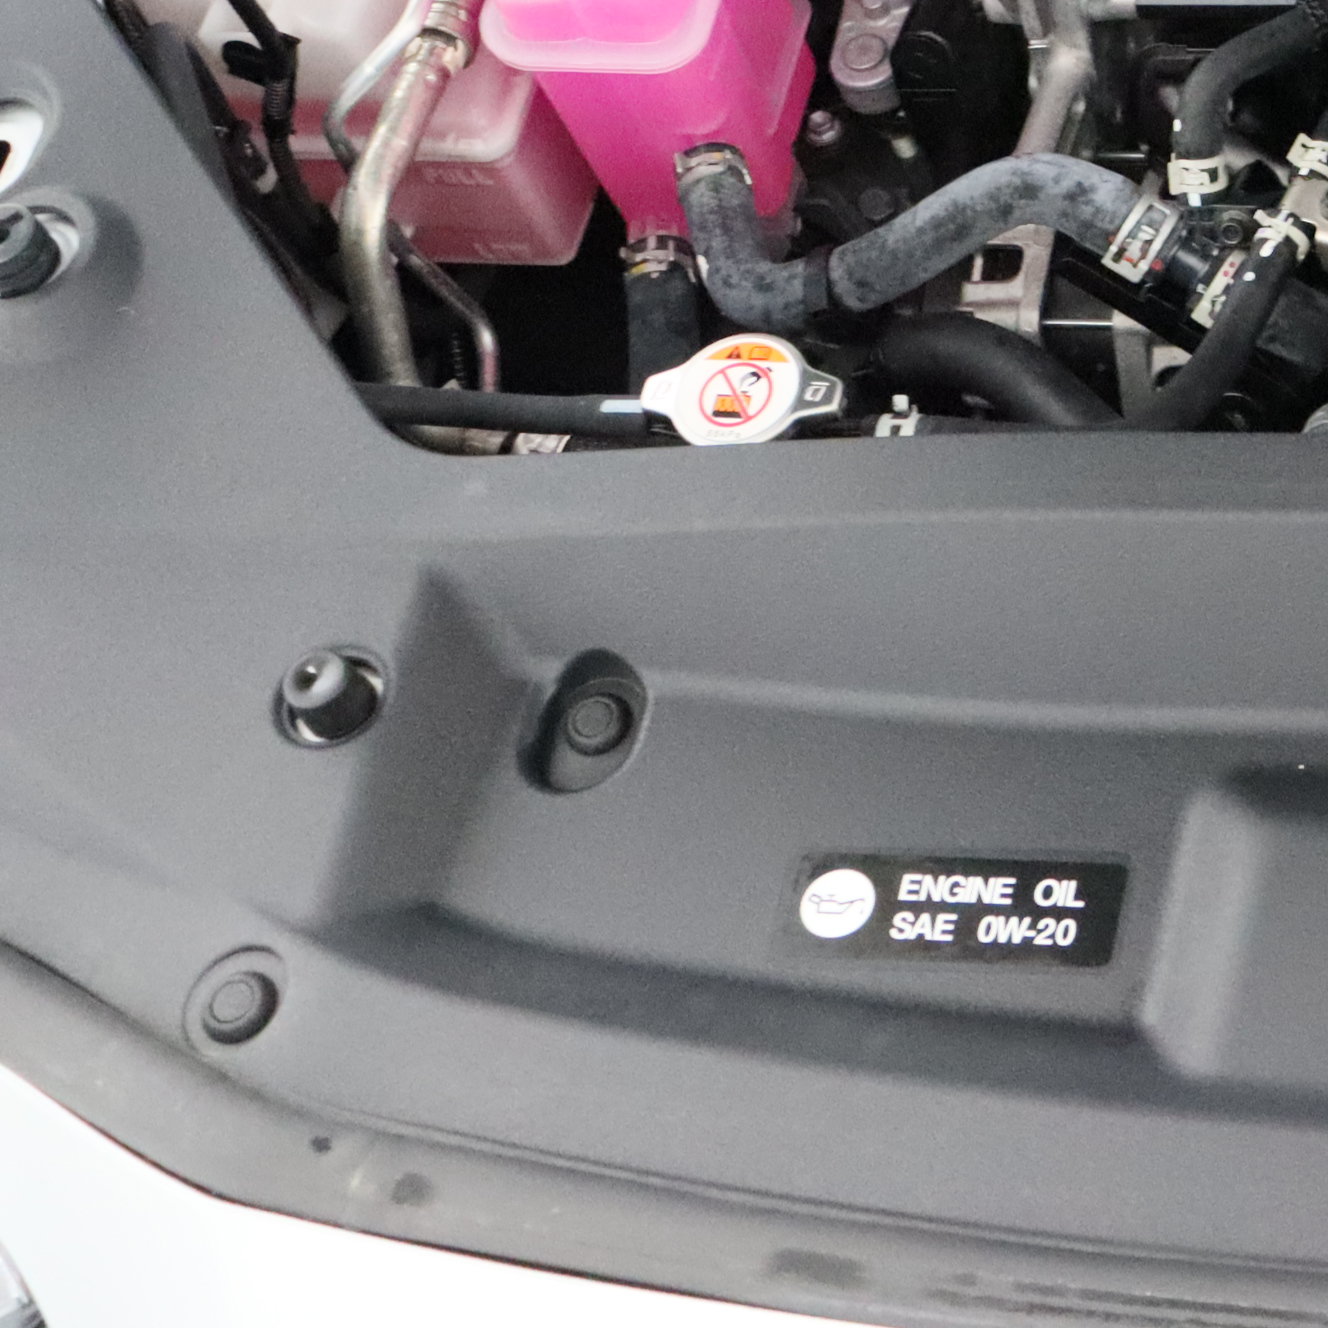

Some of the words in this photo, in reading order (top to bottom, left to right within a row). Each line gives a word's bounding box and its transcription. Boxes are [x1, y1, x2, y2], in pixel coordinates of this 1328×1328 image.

[897, 873, 1018, 905] ENGINE
[1033, 878, 1086, 909] OIL
[889, 911, 958, 942] SAE
[976, 916, 1077, 947] 0W-20
